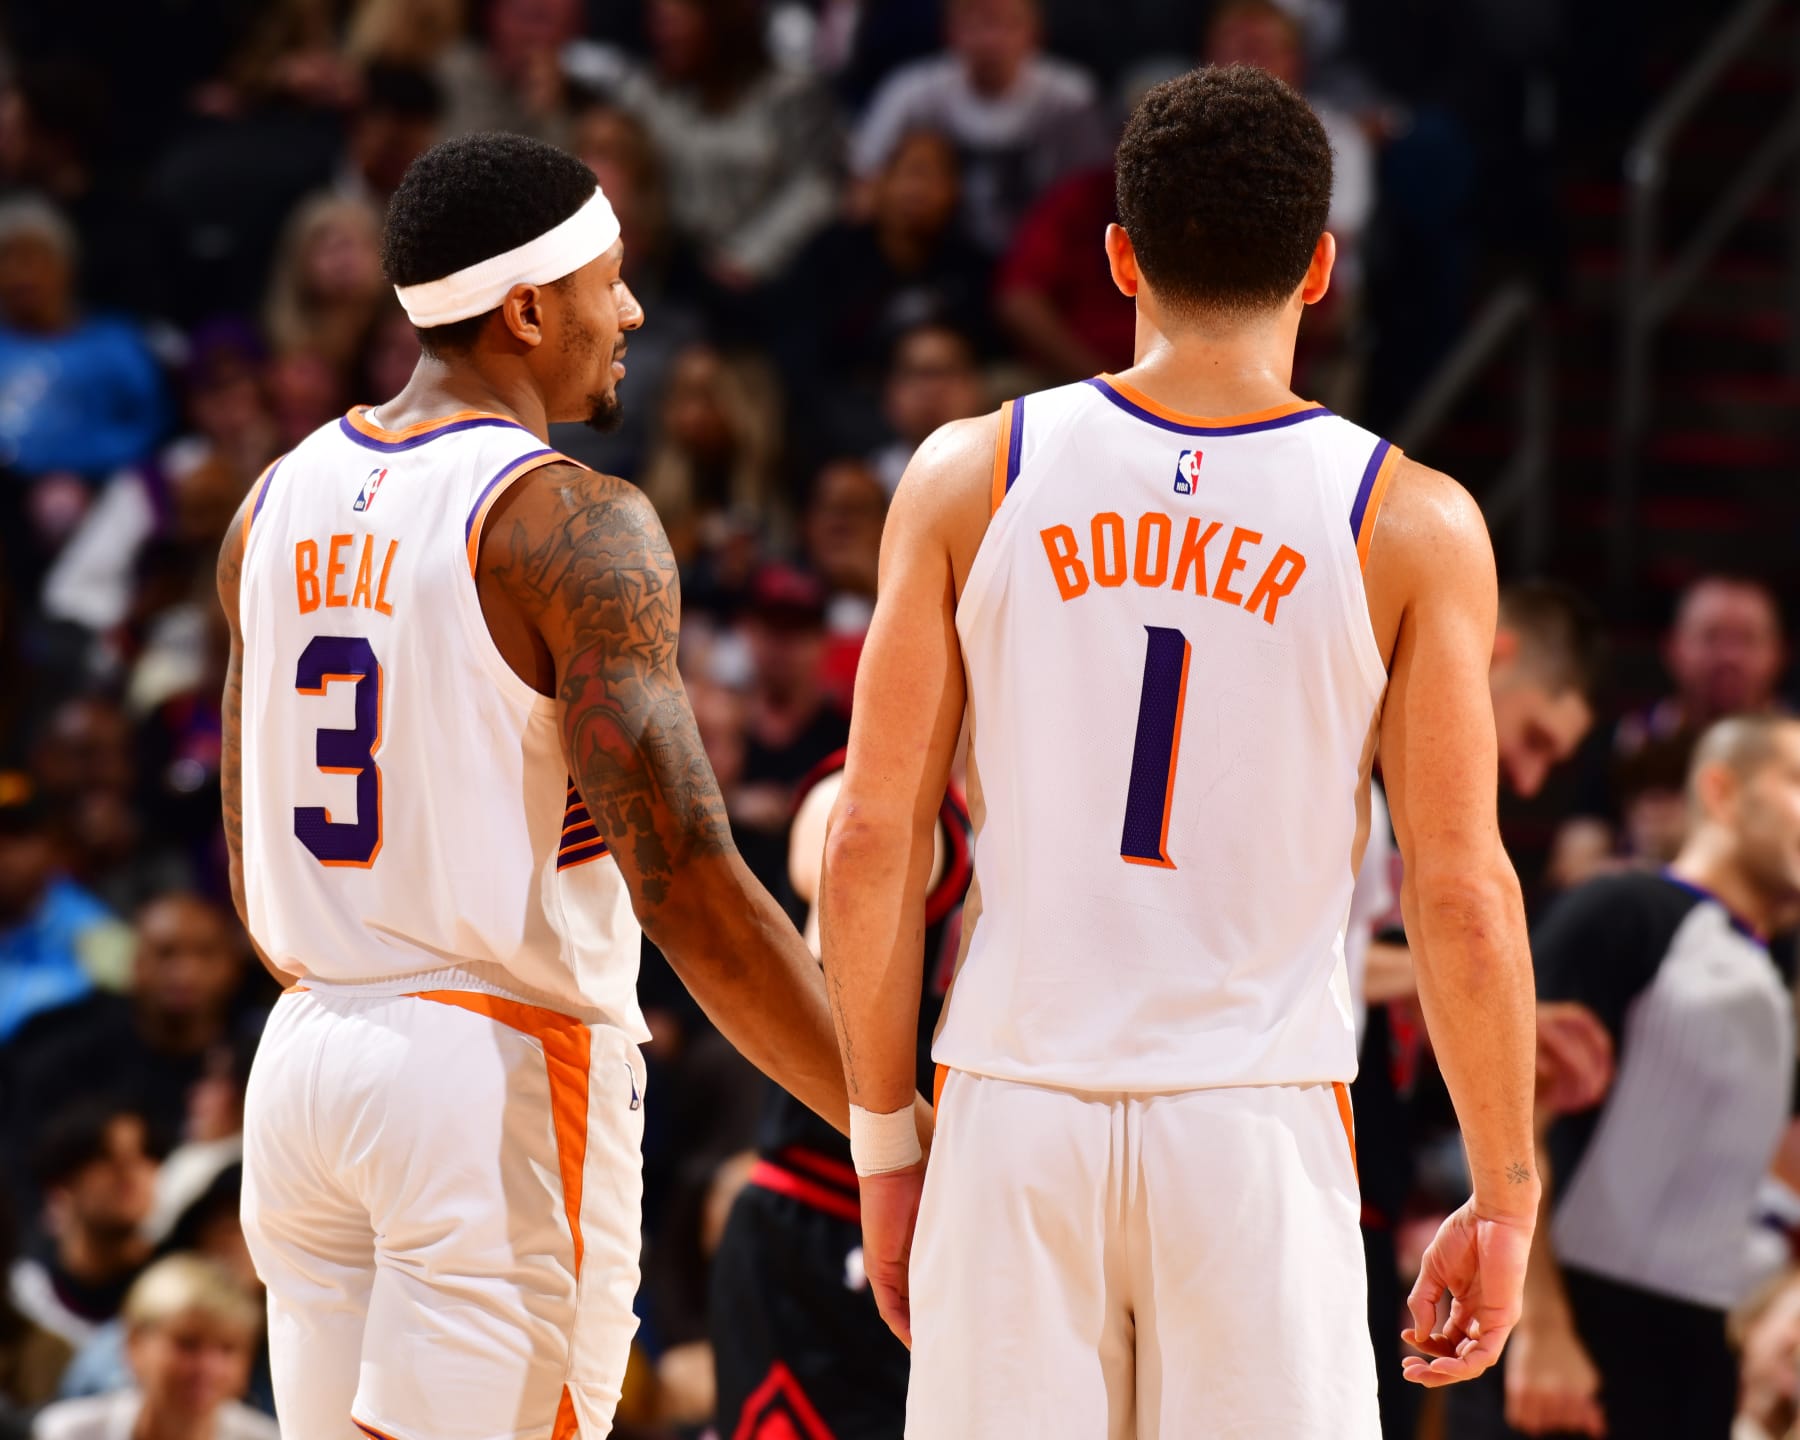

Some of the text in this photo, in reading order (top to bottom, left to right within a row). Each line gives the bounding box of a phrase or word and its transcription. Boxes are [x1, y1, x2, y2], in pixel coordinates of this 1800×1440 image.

[296, 535, 398, 616] BEAL
[1040, 512, 1306, 625] BOOKER
[294, 636, 383, 869] 3
[1121, 626, 1190, 869] 1
